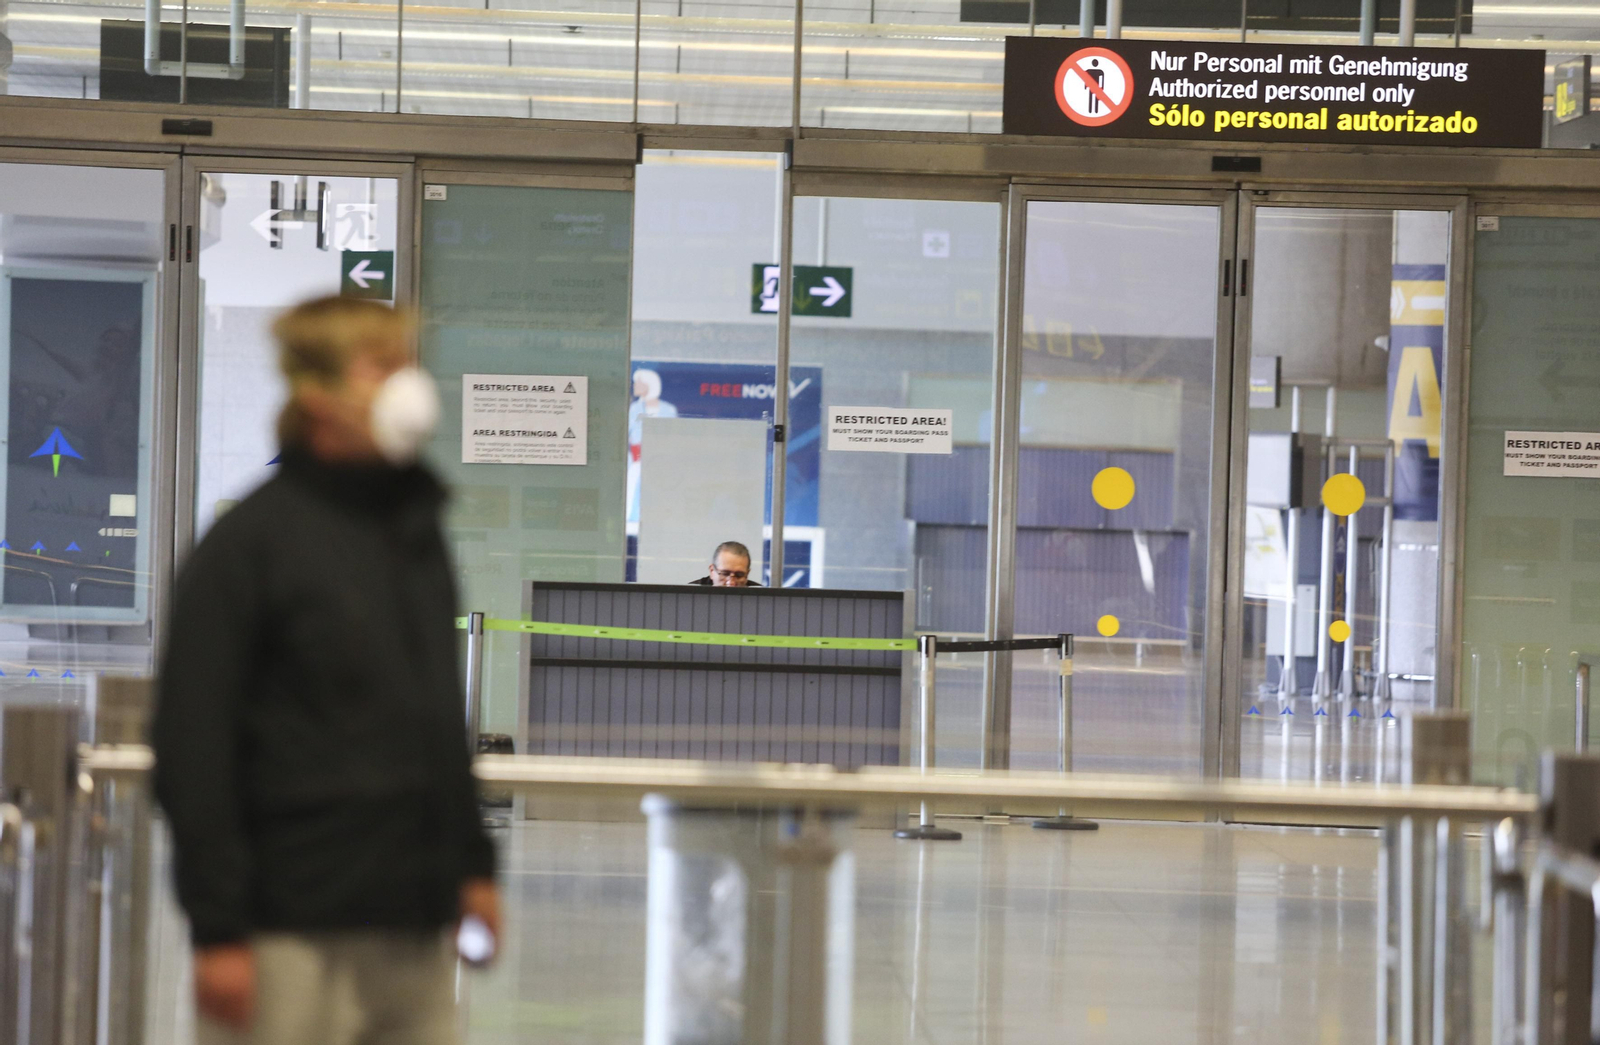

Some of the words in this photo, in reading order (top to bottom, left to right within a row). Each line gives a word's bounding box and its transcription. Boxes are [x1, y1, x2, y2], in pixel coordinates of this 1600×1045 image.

[1150, 50, 1188, 72] Nur
[1193, 51, 1283, 75] Personal
[1289, 54, 1323, 76] mit
[1328, 56, 1469, 84] Genehmigung
[1148, 76, 1258, 100] Authorized
[1264, 81, 1366, 104] personnel
[1372, 82, 1416, 108] only
[1148, 102, 1206, 129] Sólo
[1213, 107, 1328, 133] personal
[1336, 110, 1478, 135] autorizado
[472, 384, 530, 392] RESTRICTED
[835, 415, 908, 425] RESTRICTED
[911, 417, 947, 426] AREA!
[499, 429, 557, 438] RESTRINGIDA
[1507, 439, 1582, 450] RESTRICTED
